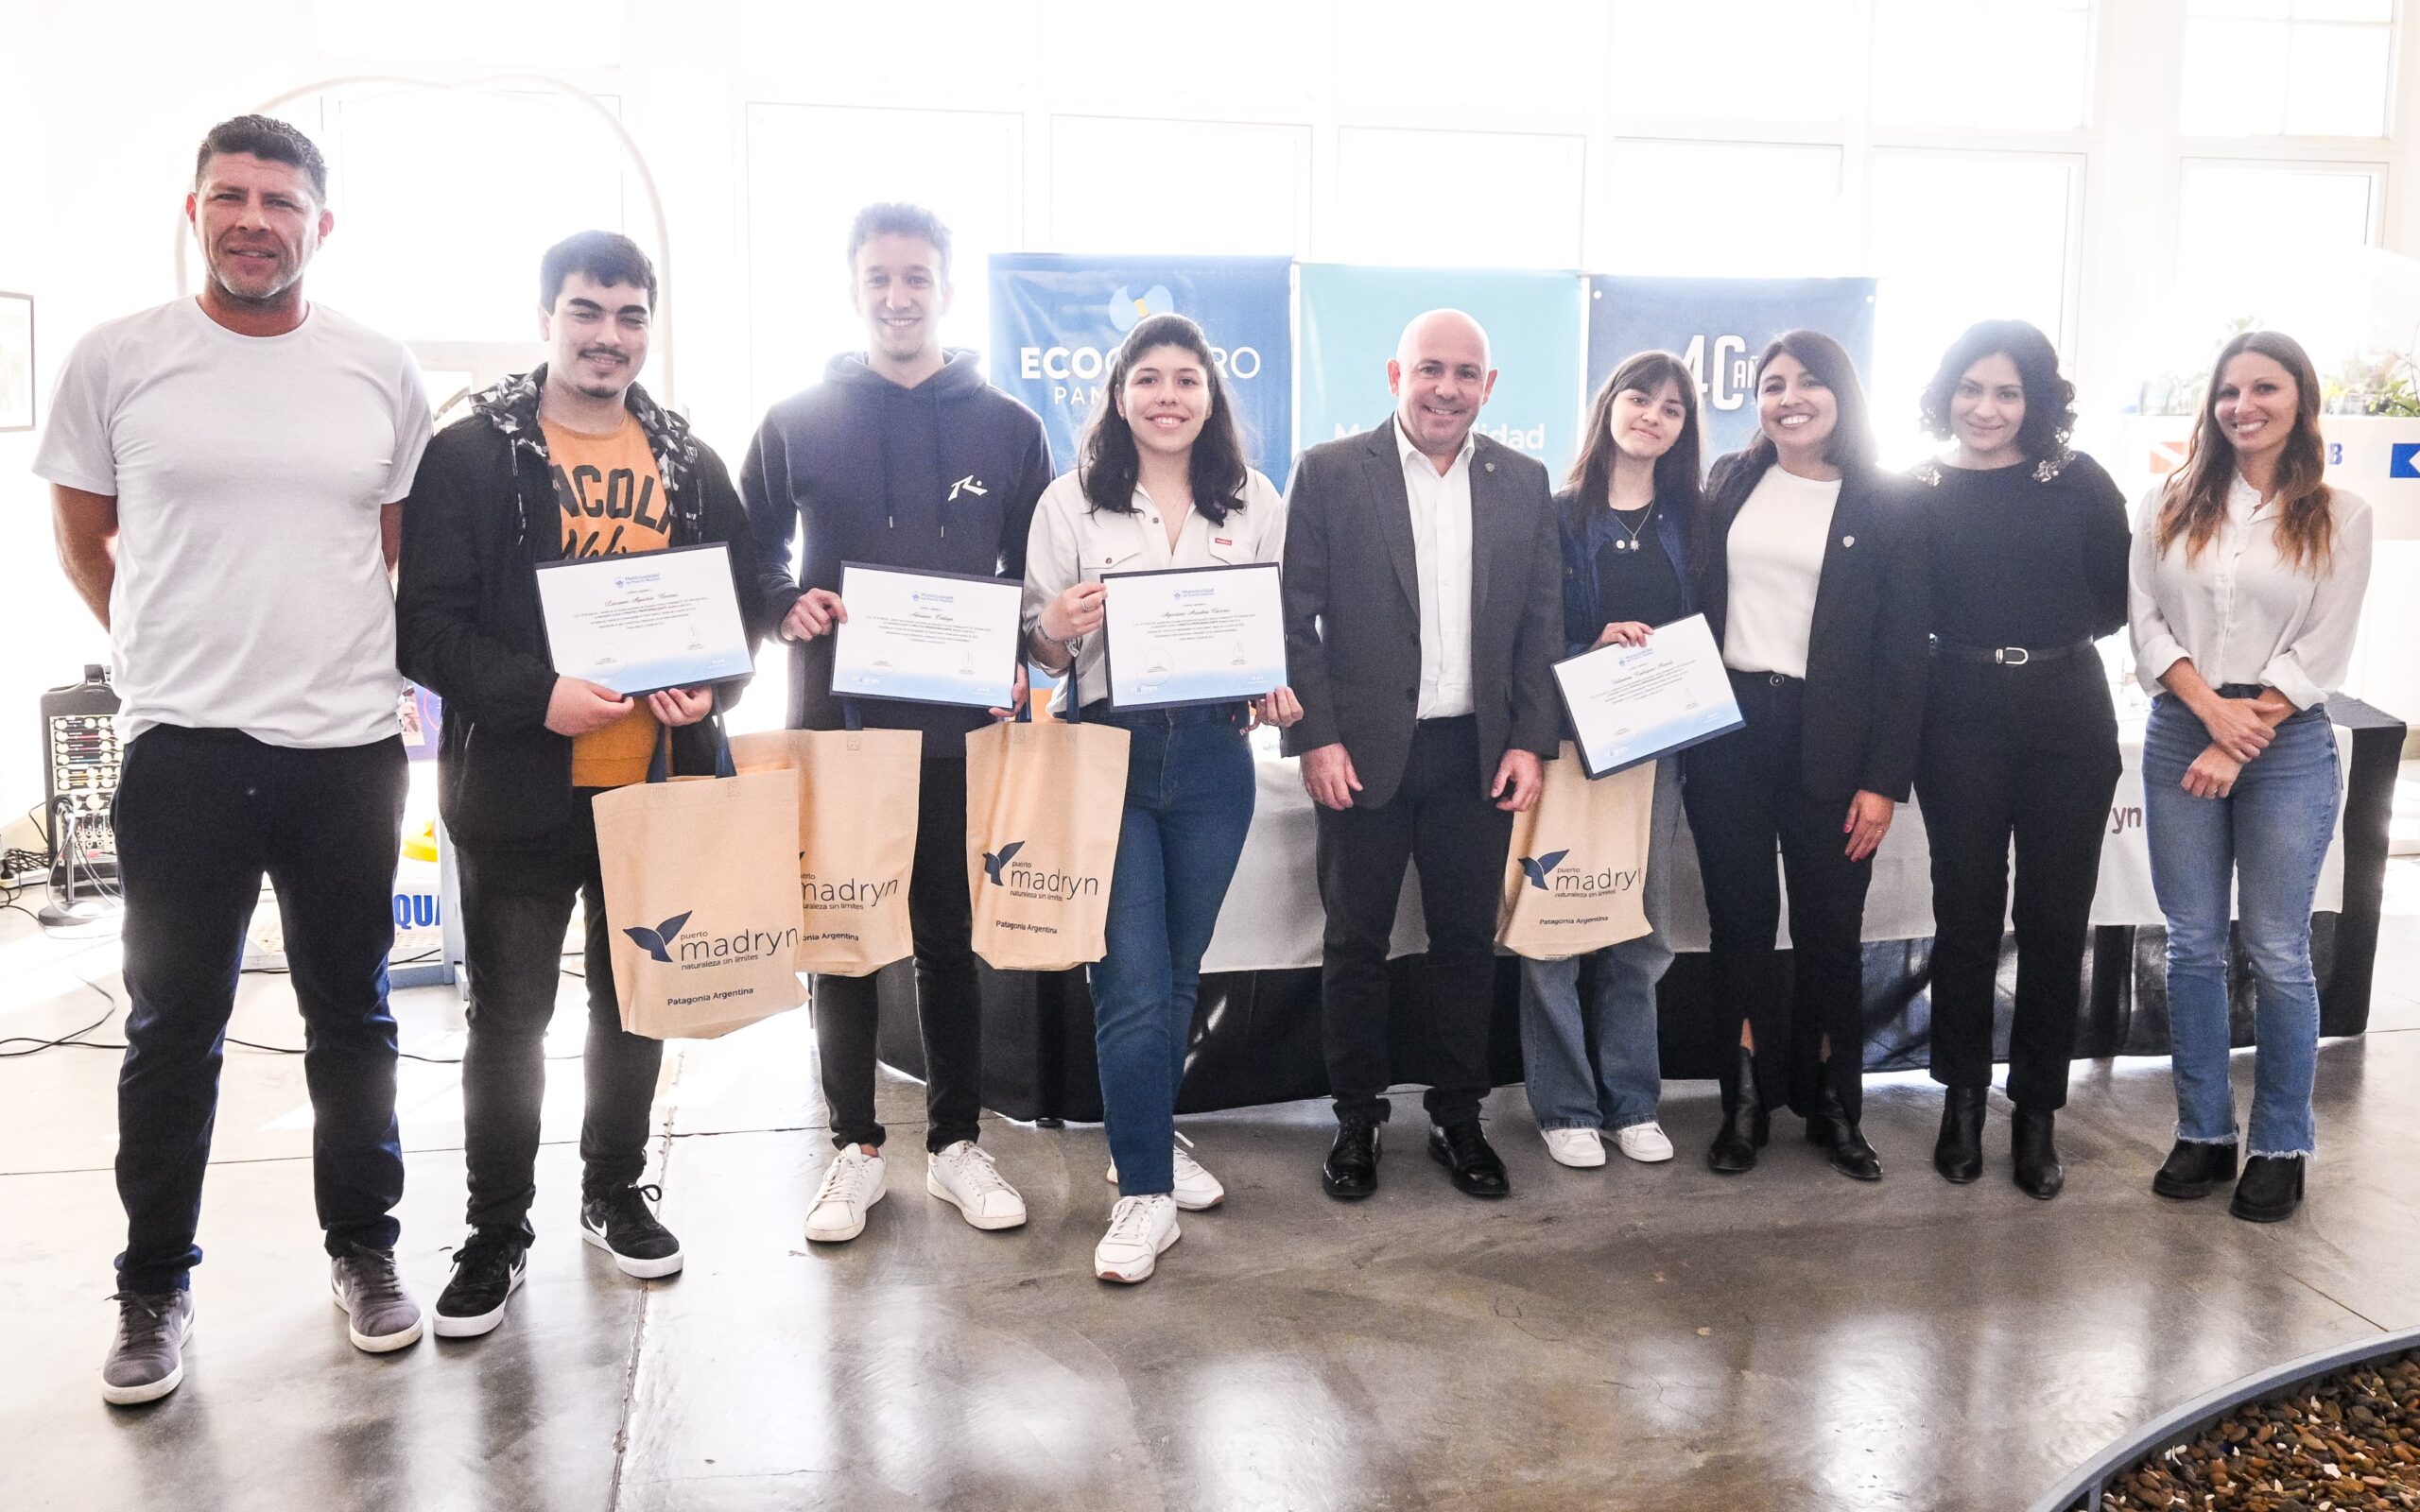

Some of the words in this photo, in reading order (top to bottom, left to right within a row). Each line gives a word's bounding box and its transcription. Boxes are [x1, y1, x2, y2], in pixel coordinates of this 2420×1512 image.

[1011, 868, 1099, 901] madryn
[995, 919, 1027, 931] Patagonia
[1027, 923, 1058, 935] Argentina
[1576, 916, 1609, 925] Argentina
[681, 931, 709, 942] puerto
[821, 932, 859, 941] Argentina
[681, 927, 799, 962] madryn
[681, 959, 721, 971] naturaleza
[667, 994, 711, 1006] Patagonia
[713, 988, 754, 1000] Argentina
